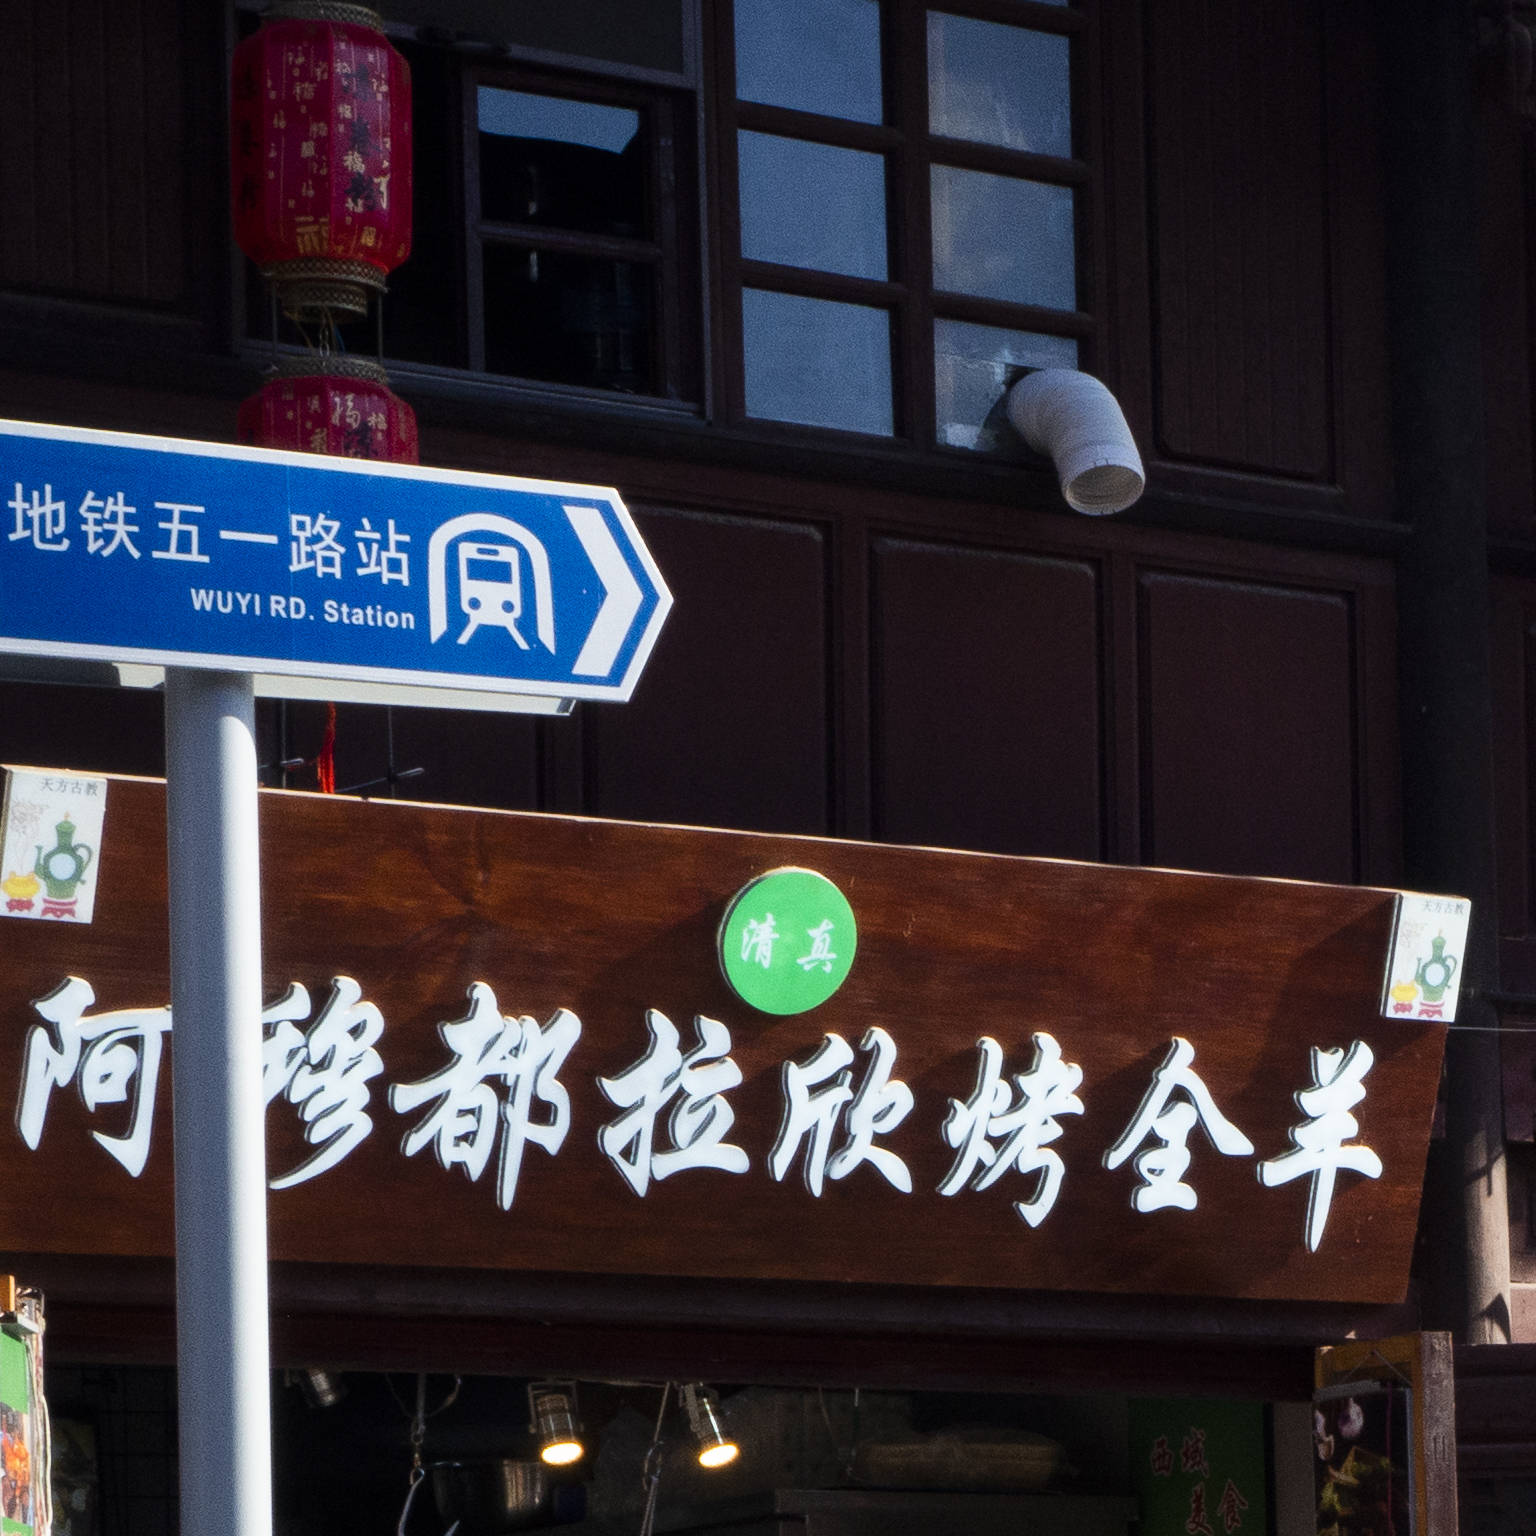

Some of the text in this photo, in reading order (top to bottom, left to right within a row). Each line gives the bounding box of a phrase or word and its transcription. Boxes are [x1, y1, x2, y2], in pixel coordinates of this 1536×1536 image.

[6, 483, 412, 587] 地铁五一路站
[190, 588, 417, 632] WUYI RD. Station
[40, 776, 99, 798] 天方古教
[1421, 898, 1466, 917] 天方古教
[741, 911, 838, 974] 清真
[1185, 1479, 1249, 1536] 美食
